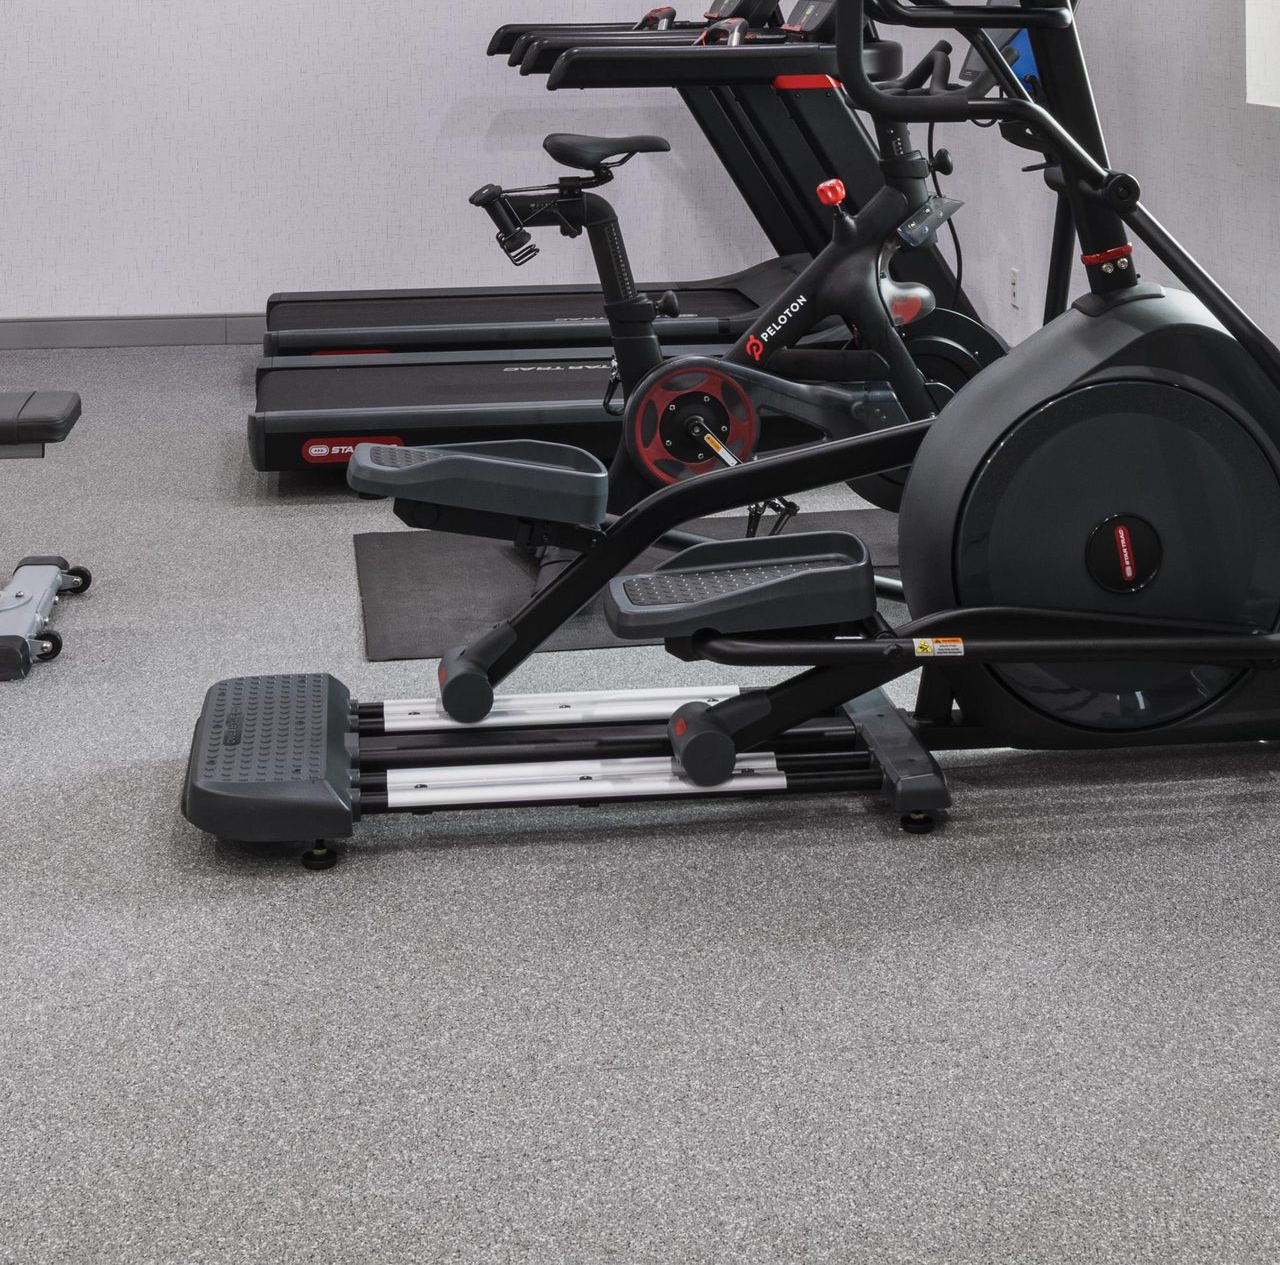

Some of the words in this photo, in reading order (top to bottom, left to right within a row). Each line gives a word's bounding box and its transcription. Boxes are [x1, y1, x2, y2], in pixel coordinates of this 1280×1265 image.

[760, 295, 808, 342] PELOTON
[331, 446, 355, 454] STA
[1118, 528, 1127, 548] TRAC
[1122, 548, 1130, 566] STAR
